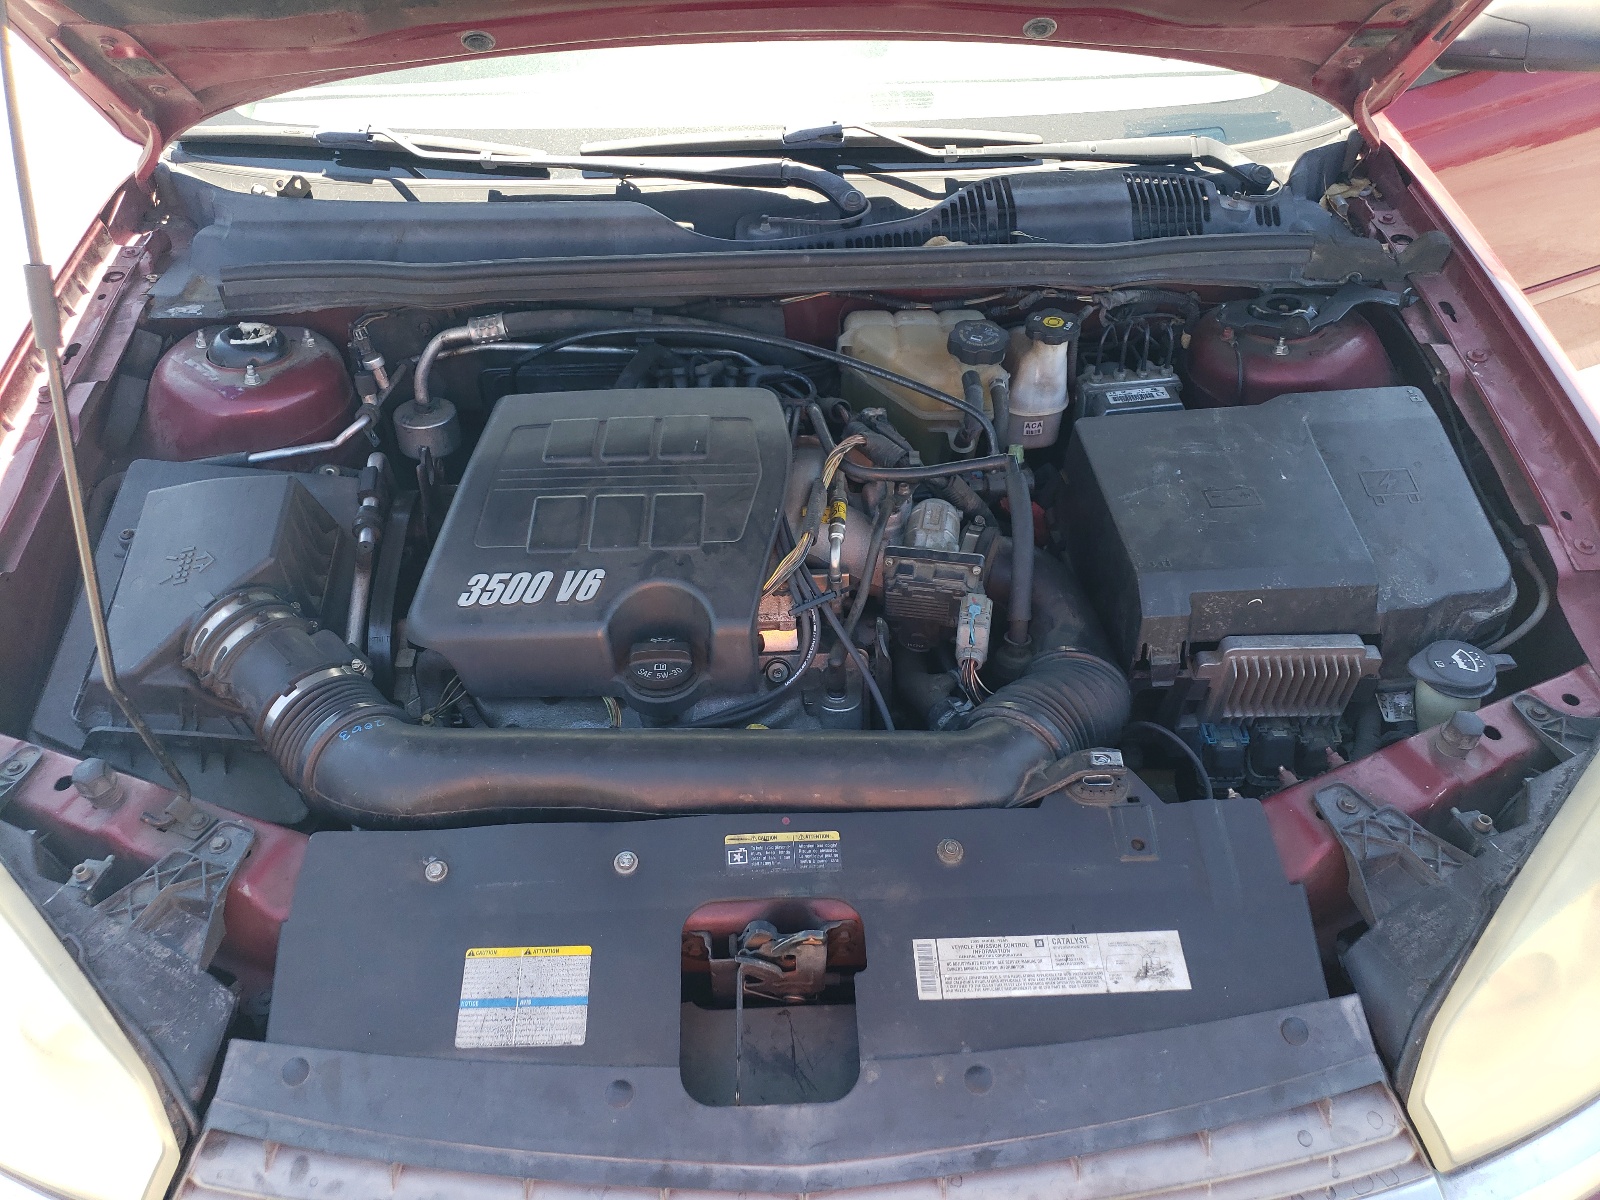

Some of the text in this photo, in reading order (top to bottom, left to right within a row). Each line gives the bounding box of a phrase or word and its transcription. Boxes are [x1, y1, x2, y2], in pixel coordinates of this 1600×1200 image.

[457, 568, 606, 607] 3500 V6
[637, 667, 683, 679] SAE 5W-30
[1052, 936, 1087, 945] CATALYST
